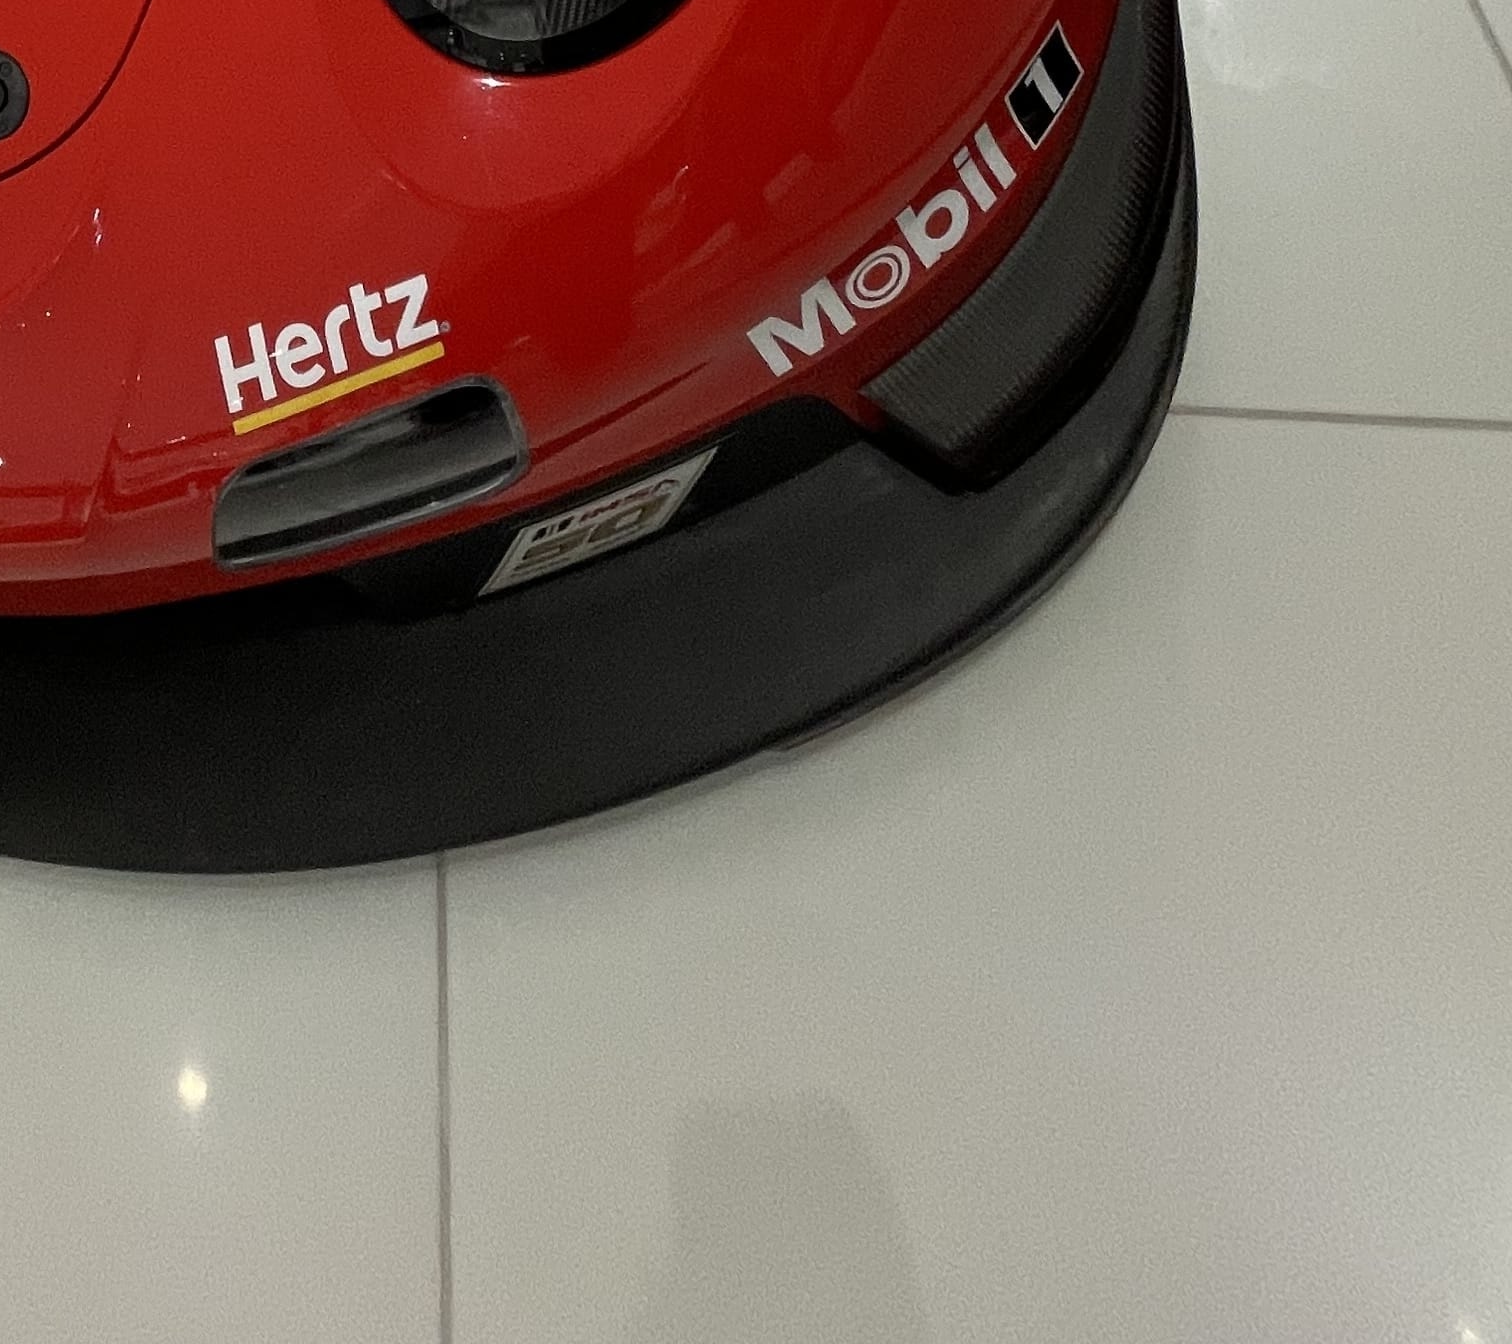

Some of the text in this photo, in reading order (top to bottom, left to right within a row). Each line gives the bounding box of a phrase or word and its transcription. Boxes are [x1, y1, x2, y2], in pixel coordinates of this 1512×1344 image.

[746, 57, 1065, 378] Mobil 1
[213, 272, 440, 414] Hertz
